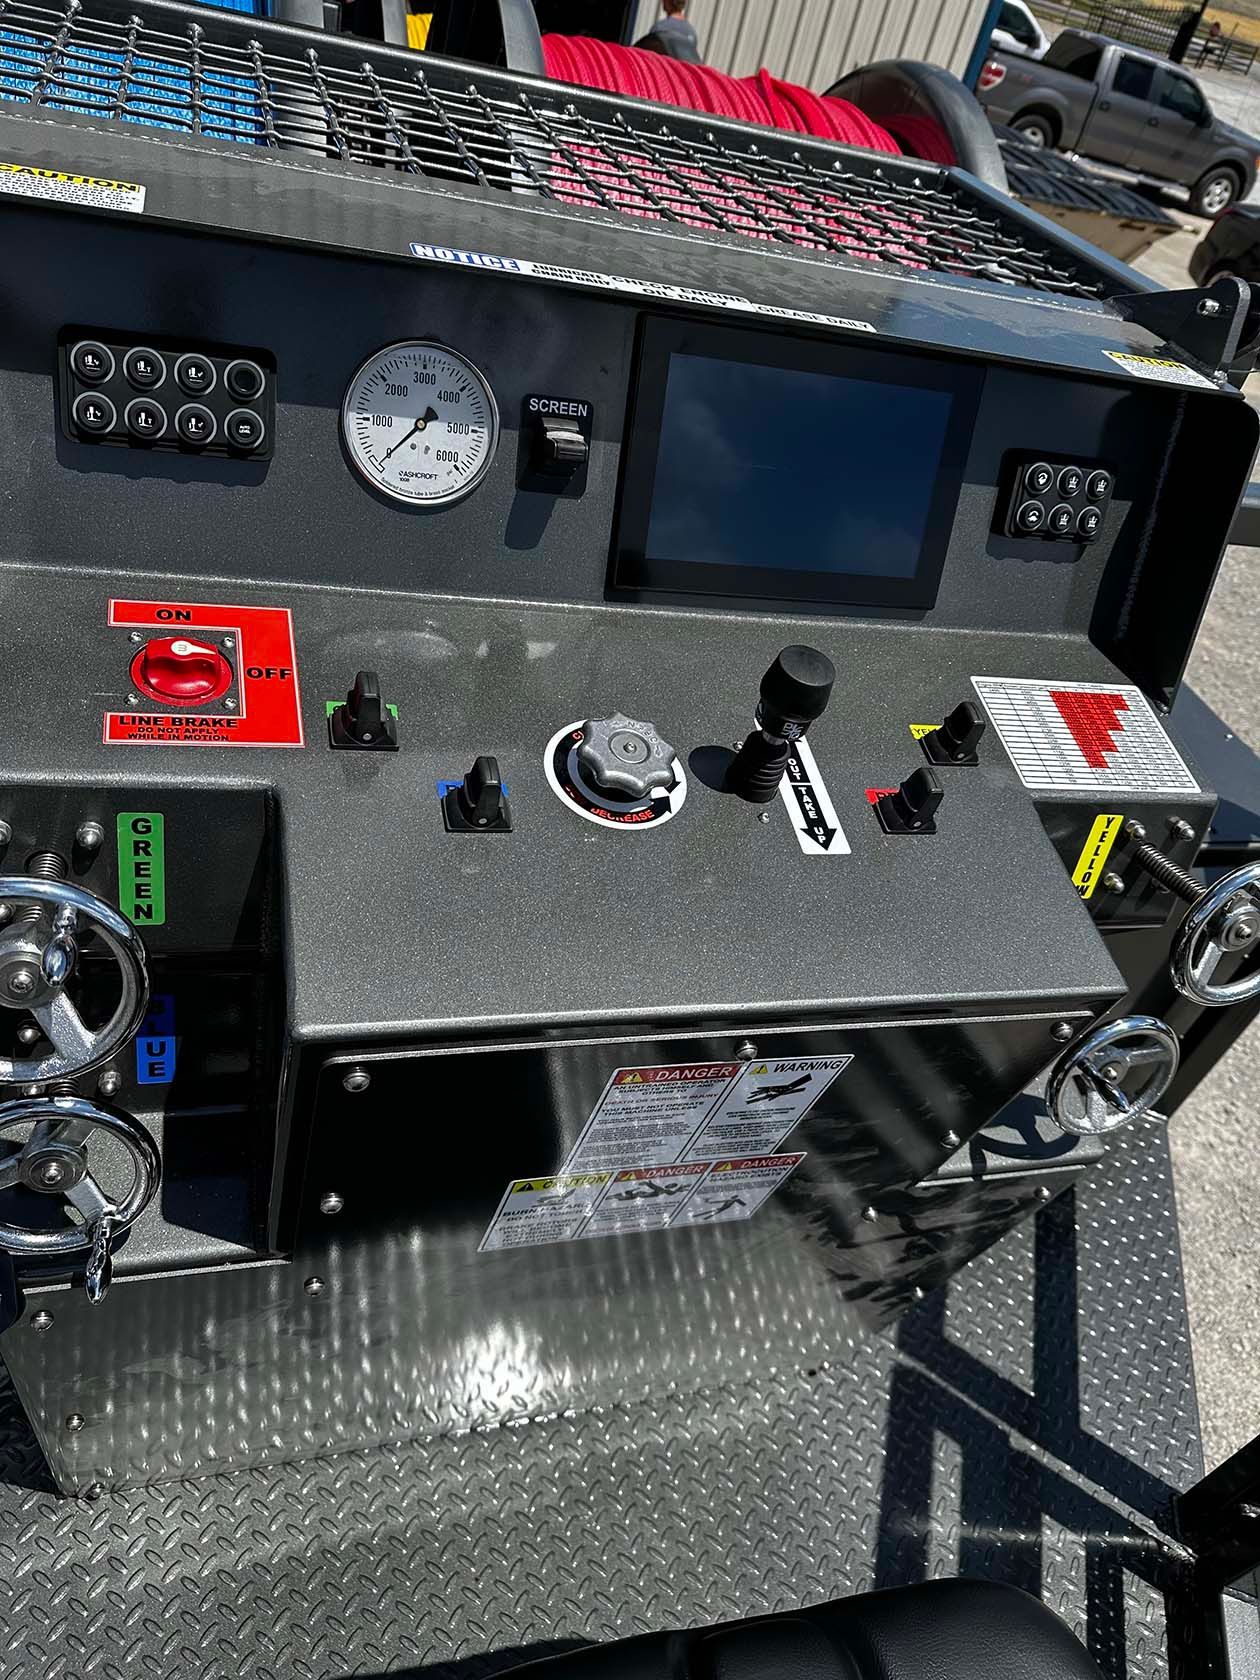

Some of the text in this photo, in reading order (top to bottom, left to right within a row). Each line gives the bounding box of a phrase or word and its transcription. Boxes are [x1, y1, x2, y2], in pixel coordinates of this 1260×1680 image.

[414, 245, 519, 271] NOTICE
[531, 269, 610, 287] CHAIN DAILY
[612, 276, 748, 304] CHECK ENGINE
[642, 288, 728, 306] OIL DAILY
[757, 306, 870, 330] GREASE DAILY
[413, 371, 437, 386] 3000
[385, 383, 409, 398] 2000
[437, 390, 461, 404] 4000
[529, 398, 588, 417] SCREEN
[371, 414, 394, 428] 1000
[447, 422, 470, 436] 5000
[436, 449, 459, 463] 6000
[404, 471, 439, 480] ASHCROFT
[156, 609, 191, 622] ON
[246, 667, 292, 681] OFF
[120, 715, 238, 728] LINE BRAKE
[184, 734, 229, 742] MOTION
[788, 758, 802, 780] OUT
[797, 787, 827, 844] TAKE UP
[1076, 816, 1115, 897] YELLOW
[131, 818, 153, 920] GREEN
[655, 1066, 734, 1081] DANGER
[773, 1060, 844, 1073] WARNING
[741, 1156, 797, 1169] DANGER
[645, 1165, 704, 1178] DANGER
